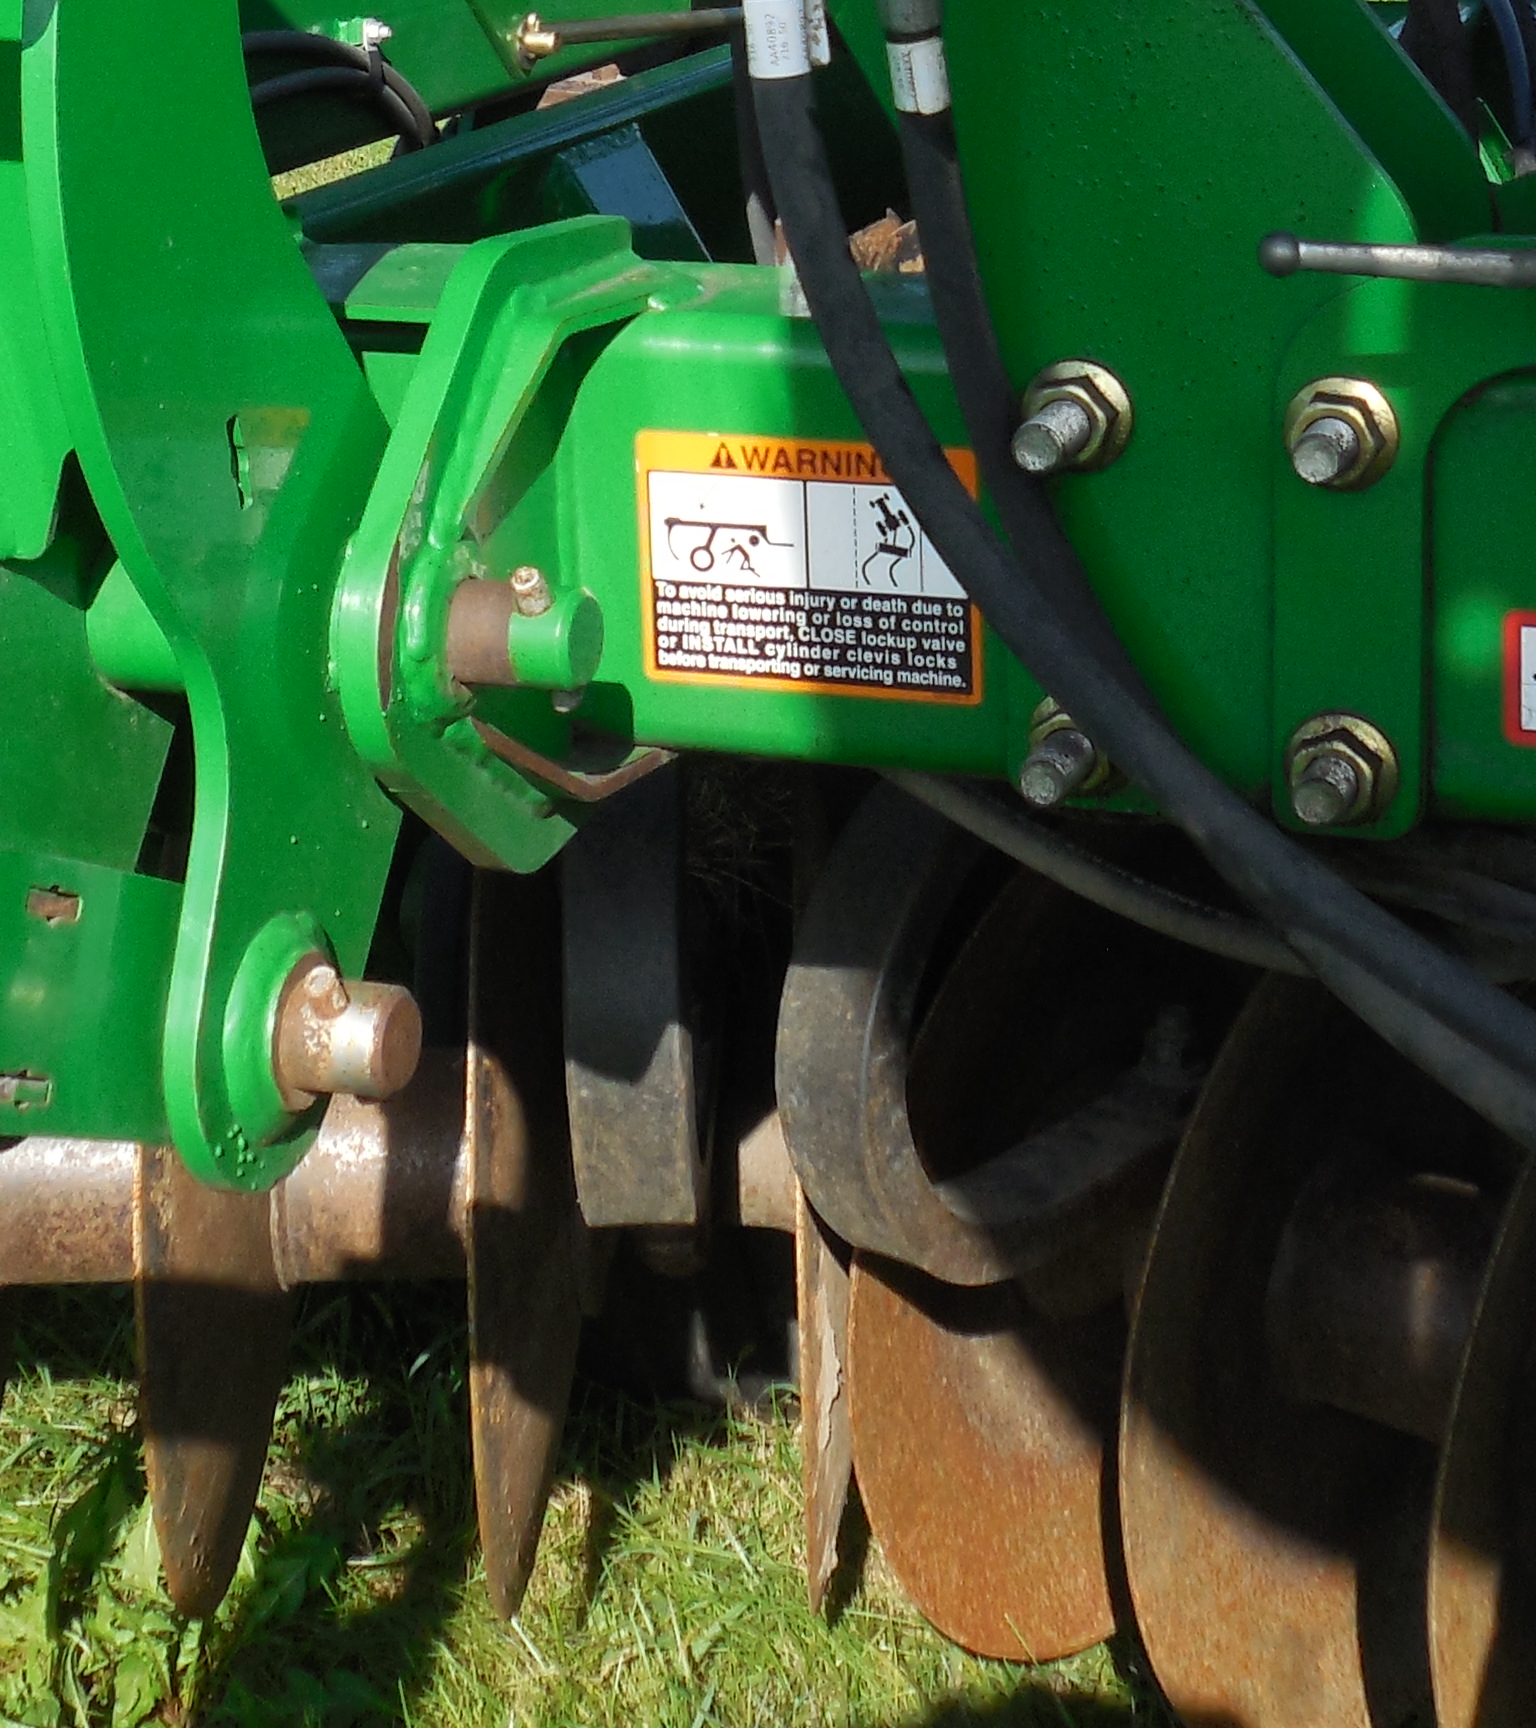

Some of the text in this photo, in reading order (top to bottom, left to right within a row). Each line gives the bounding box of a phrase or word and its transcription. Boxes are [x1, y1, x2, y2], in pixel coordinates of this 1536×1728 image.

[740, 445, 886, 477] WARNIN
[655, 581, 963, 617] To avoid serious injury or death due to
[656, 600, 964, 635] machine lowering or loss of control
[657, 616, 966, 652] during transport, CLOSE lockup valve
[657, 634, 957, 669] or INSTALL cylinder clevis locks
[658, 649, 967, 688] before transporting or servicing machine.
